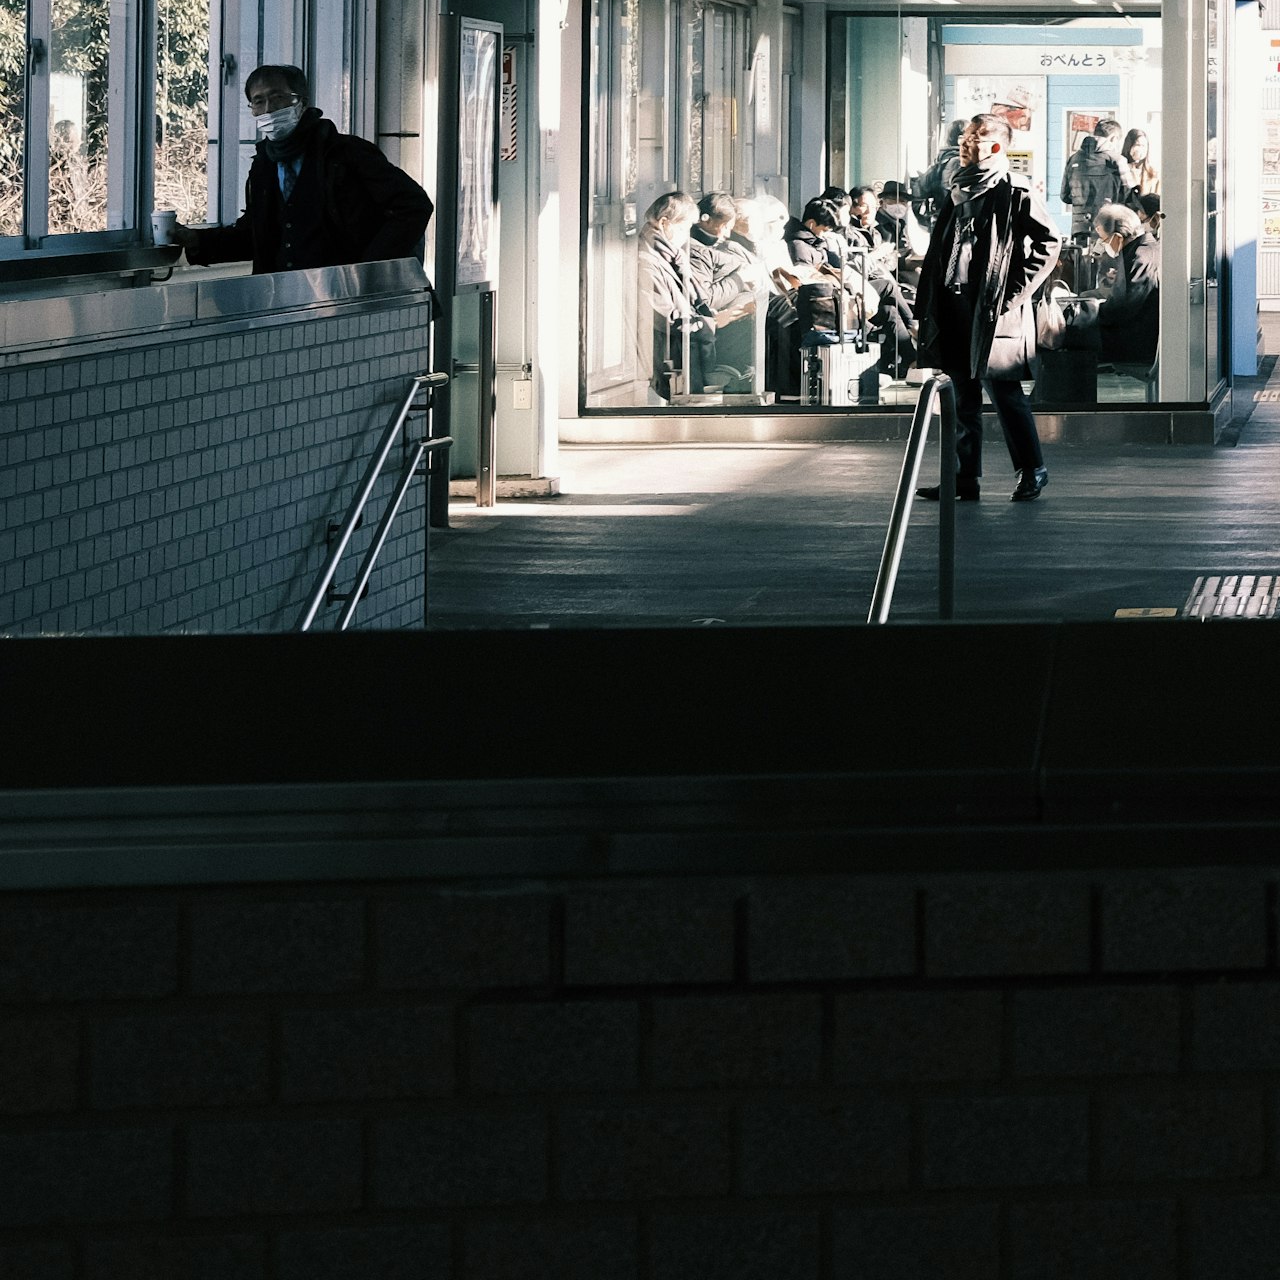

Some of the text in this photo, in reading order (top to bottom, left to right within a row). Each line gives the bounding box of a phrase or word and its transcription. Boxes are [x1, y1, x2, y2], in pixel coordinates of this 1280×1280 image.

[1040, 53, 1107, 67] おべんとう
